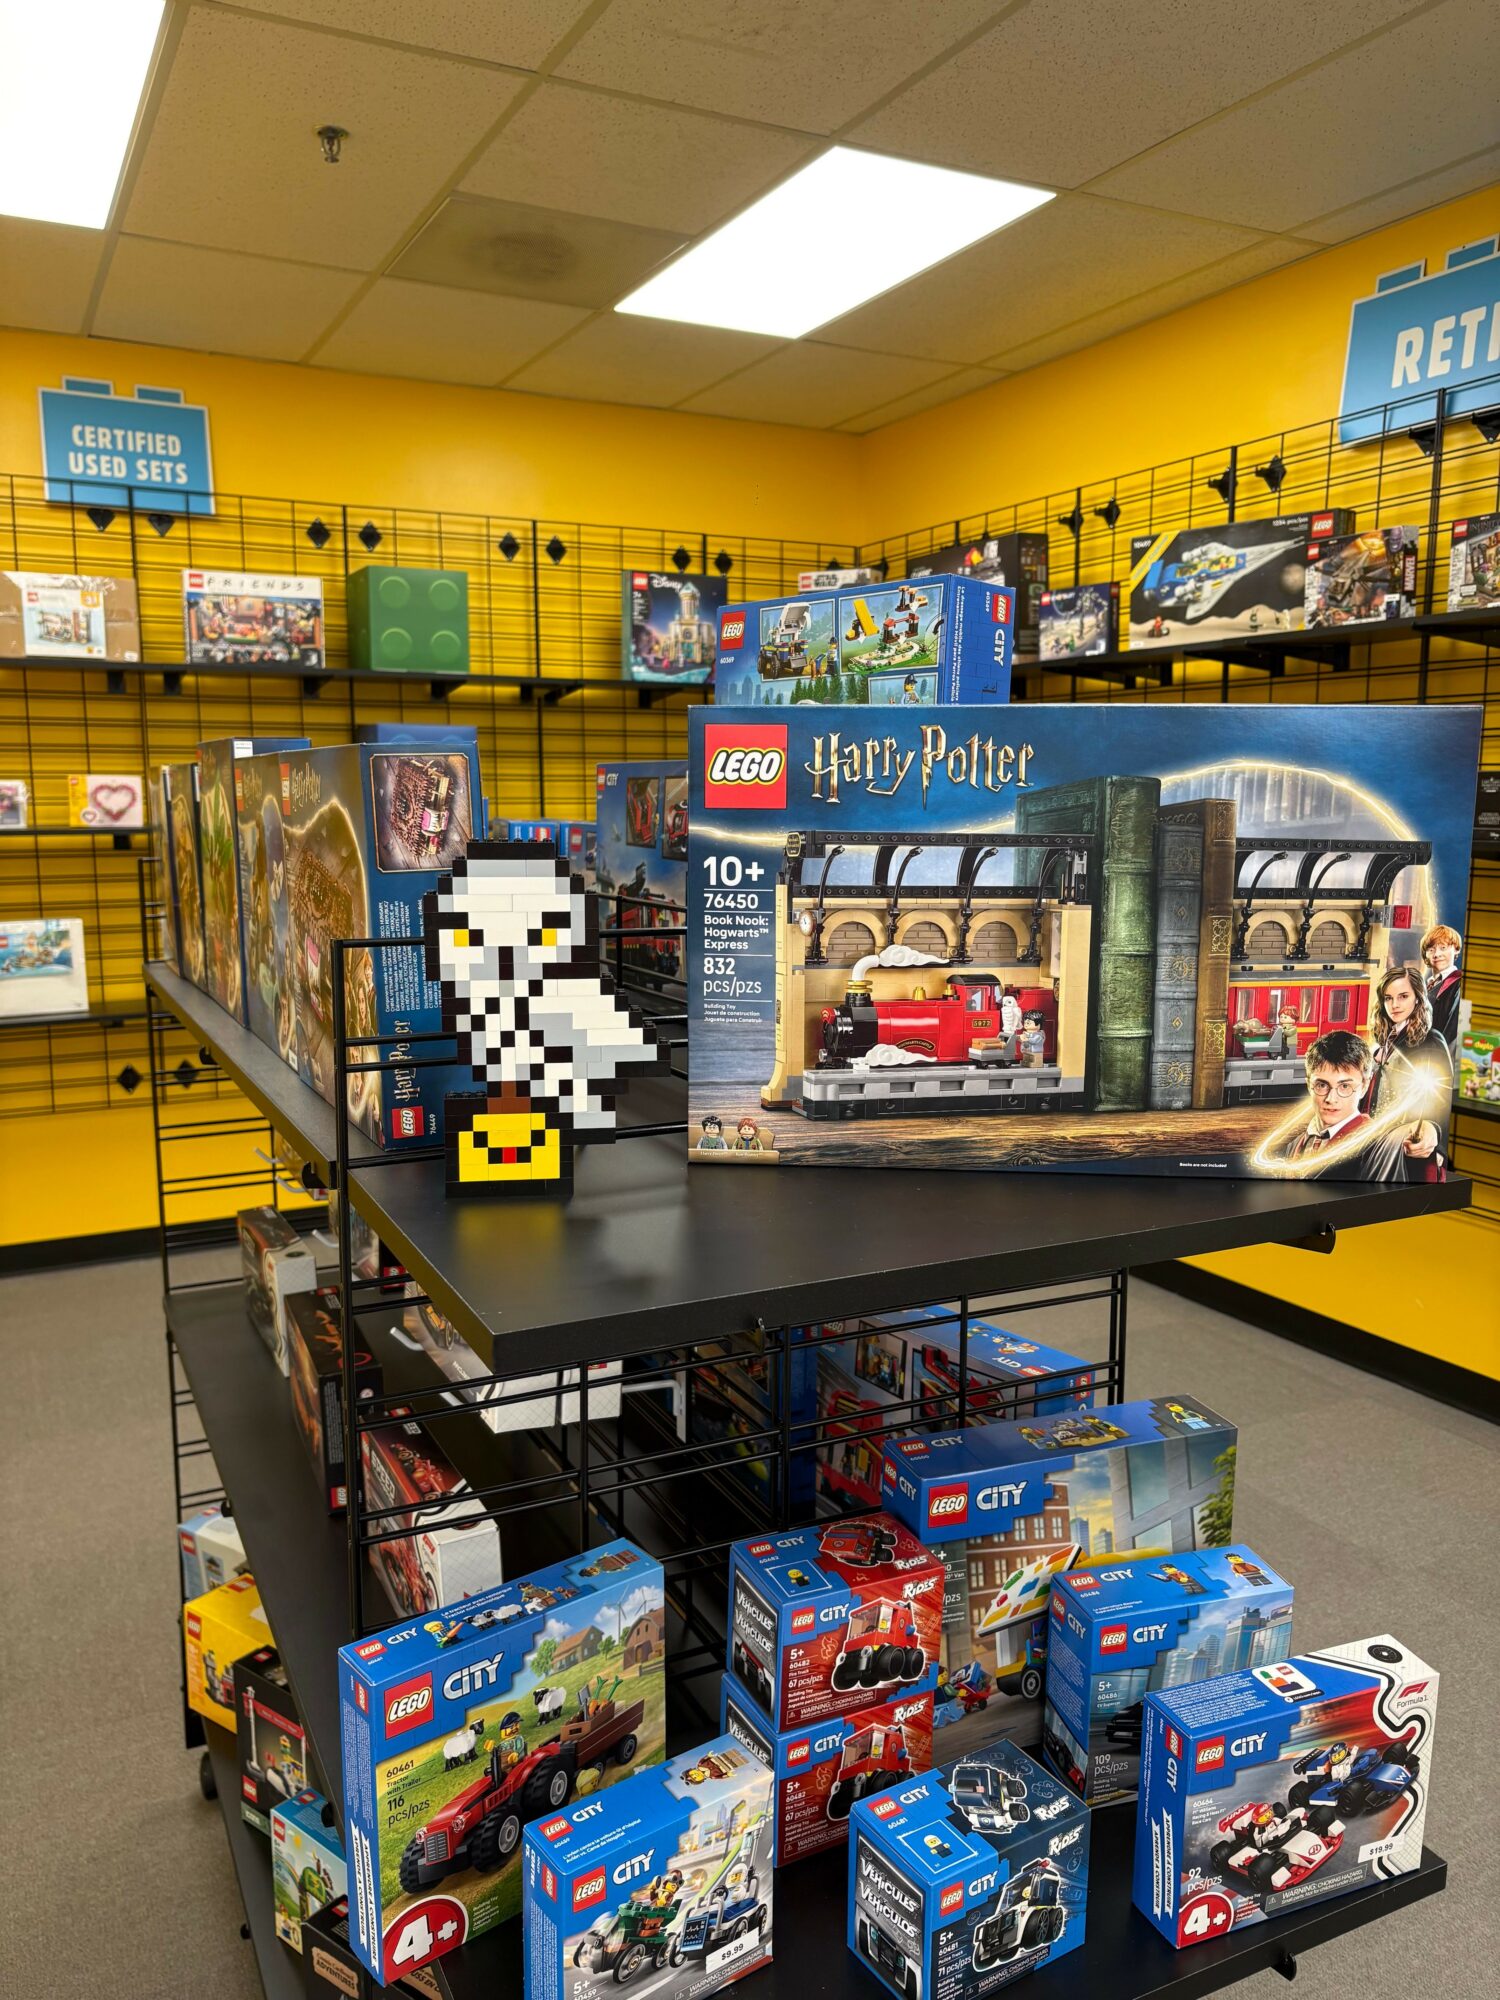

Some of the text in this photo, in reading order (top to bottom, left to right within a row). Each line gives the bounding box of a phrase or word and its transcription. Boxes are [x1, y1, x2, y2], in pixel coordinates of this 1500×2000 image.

[72, 424, 182, 457] CERTIFIED
[68, 452, 188, 485] USED SETS
[650, 573, 683, 592] Disney
[1403, 556, 1416, 591] MARVEL
[998, 594, 1007, 623] LEGO
[721, 622, 744, 640] LEGO
[993, 628, 1006, 667] CITY
[719, 656, 735, 665] 60369
[709, 749, 783, 784] LEGO
[804, 724, 1034, 810] Harry Potter
[703, 855, 765, 887] 10+
[703, 893, 759, 909] 76450
[704, 915, 769, 926] Book Nook:
[704, 939, 749, 951] Express
[703, 957, 736, 975] 832
[703, 976, 762, 997] pcs/pzs
[1473, 1039, 1495, 1052] duplo
[388, 1019, 420, 1102] Harr Poer
[401, 1108, 415, 1136] LEGO
[429, 1114, 437, 1135] 76449
[902, 1436, 963, 1452] LEGO CITY
[885, 1463, 917, 1501] LEGO CITY
[930, 1480, 1029, 1517] LEGO CITY
[751, 1536, 805, 1555] LEGO CITY
[759, 1555, 780, 1564] 60482
[1071, 1569, 1134, 1587] LEGO CITY
[792, 1603, 850, 1628] LEGO CITY
[1053, 1597, 1065, 1614] LEGO
[1067, 1613, 1087, 1640] CITY
[359, 1627, 417, 1656] LEGO CITY
[1101, 1623, 1169, 1648] LEGO CITY
[790, 1649, 804, 1660] 5+
[789, 1660, 810, 1669] 60482
[387, 1652, 504, 1723] LEGO CITY
[788, 1675, 824, 1688] 67 pcs/pzs
[1098, 1681, 1112, 1692] 5+
[1097, 1692, 1118, 1701] 60486
[1397, 1697, 1423, 1708] Formula
[789, 1731, 843, 1761] LEGO CITY
[1169, 1732, 1178, 1754] LEGO
[1197, 1731, 1268, 1764] LEGO CITY
[386, 1760, 414, 1778] 60461
[1094, 1754, 1111, 1765] 109
[1094, 1761, 1129, 1777] pcs/pzs
[387, 1776, 409, 1788] Tractor
[1166, 1757, 1178, 1793] CITY
[387, 1778, 421, 1795] with Trailer
[786, 1781, 800, 1793] 5+
[387, 1795, 405, 1811] 116
[874, 1786, 930, 1816] LEGO CITY
[388, 1799, 430, 1828] pcs/pzs
[546, 1801, 604, 1836] LEGO CITY
[785, 1805, 819, 1822] 67 pcs/pzs
[887, 1817, 908, 1830] 60481
[554, 1838, 570, 1849] 60459
[1369, 1842, 1394, 1855] $19.99
[575, 1848, 656, 1902] LEGO CITY
[1188, 1867, 1202, 1880] 92
[1317, 1876, 1342, 1888] CHOKING
[354, 1835, 362, 1876] APRENDE
[358, 1887, 366, 1936] CONSTRUIR
[941, 1870, 999, 1909] LEGO CITY
[1187, 1875, 1223, 1895] pcs/pzs
[364, 1844, 377, 1962] APPRENDRE CONSTRUIRE
[1183, 1903, 1227, 1937] 4+
[392, 1914, 458, 1966] 4+
[939, 1932, 954, 1945] 5+
[721, 1943, 744, 1960] $9.99
[939, 1942, 959, 1956] 60481
[938, 1955, 951, 1965] Police
[938, 1956, 972, 1977] 71 pcs/pzs
[573, 1980, 590, 1995] 5+
